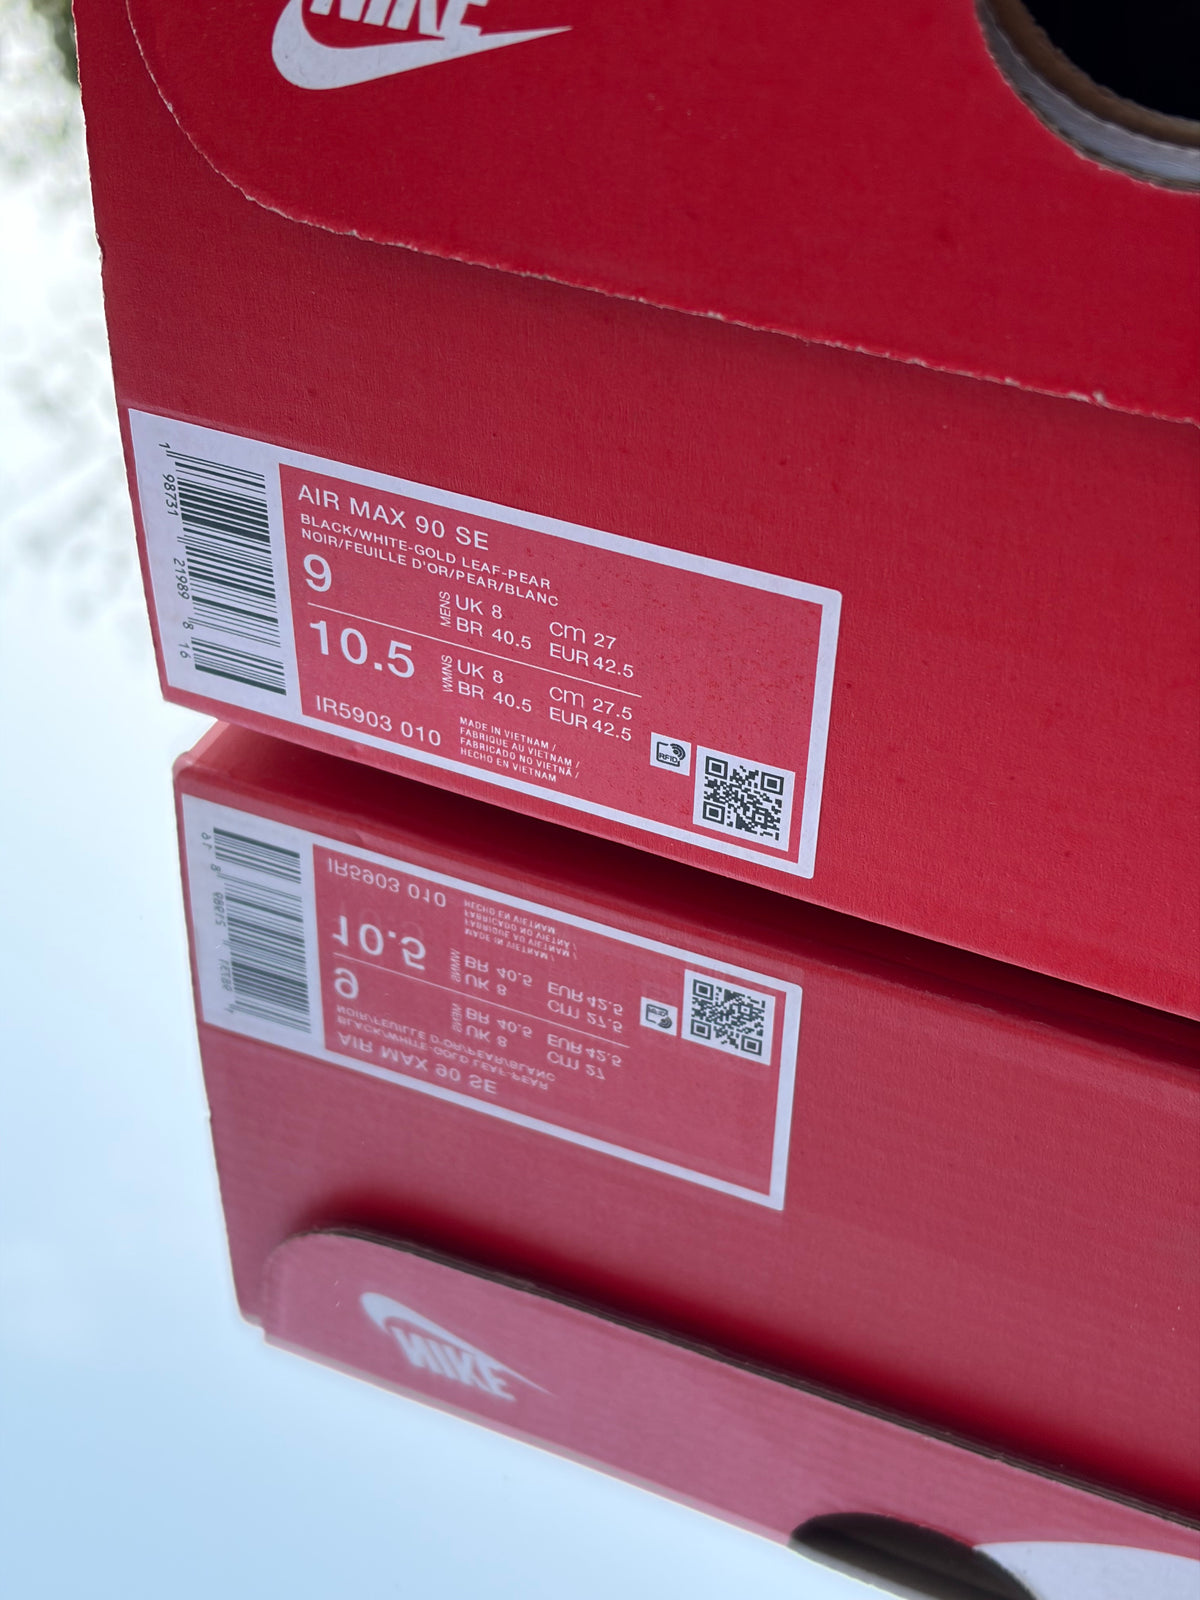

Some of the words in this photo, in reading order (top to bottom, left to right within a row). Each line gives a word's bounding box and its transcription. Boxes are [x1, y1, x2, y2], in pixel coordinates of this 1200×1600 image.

[158, 442, 171, 450] 1
[161, 473, 179, 517] 98731
[298, 484, 340, 511] AIR
[350, 497, 406, 529] MAX
[416, 515, 445, 539] 90
[456, 526, 489, 551] SE
[301, 513, 456, 564] BLACK/WHITE-GOLD
[462, 556, 551, 590] LEAF-PEAR
[301, 528, 407, 566] NOIR/FEUILLE
[412, 558, 559, 607] D'OR/PEAR/BLANC
[173, 557, 191, 600] 21989
[303, 554, 332, 592] 9
[439, 591, 451, 628] MENS
[455, 594, 484, 616] UK
[491, 605, 503, 619] 8
[182, 620, 195, 631] 8
[456, 617, 483, 637] BR
[492, 628, 532, 650] 40.5
[594, 632, 617, 650] 27
[178, 642, 191, 659] 16
[309, 620, 415, 678] 10.5
[550, 643, 589, 667] EUR
[594, 657, 634, 679] 42.5
[441, 655, 454, 693] WMNS
[457, 659, 485, 679] UK
[492, 670, 504, 684] 8
[458, 680, 485, 700] BR
[493, 691, 532, 712] 40.5
[593, 698, 633, 721] 27.5
[316, 695, 393, 732] IR5903
[401, 721, 441, 746] 010
[460, 716, 488, 731] MADE
[491, 725, 501, 736] IN
[504, 730, 549, 749] VIETNAM
[550, 706, 588, 730] EUR
[592, 719, 632, 742] 42.5
[460, 727, 508, 748] FABRIQUE
[511, 743, 524, 753] AU
[528, 747, 572, 767] VIETNAM
[460, 737, 516, 760] FABRICADO
[520, 754, 533, 765] NO
[460, 747, 493, 763] HECHO
[497, 758, 509, 768] EN
[512, 762, 557, 782] VIETNAM
[658, 752, 678, 764] RFID
